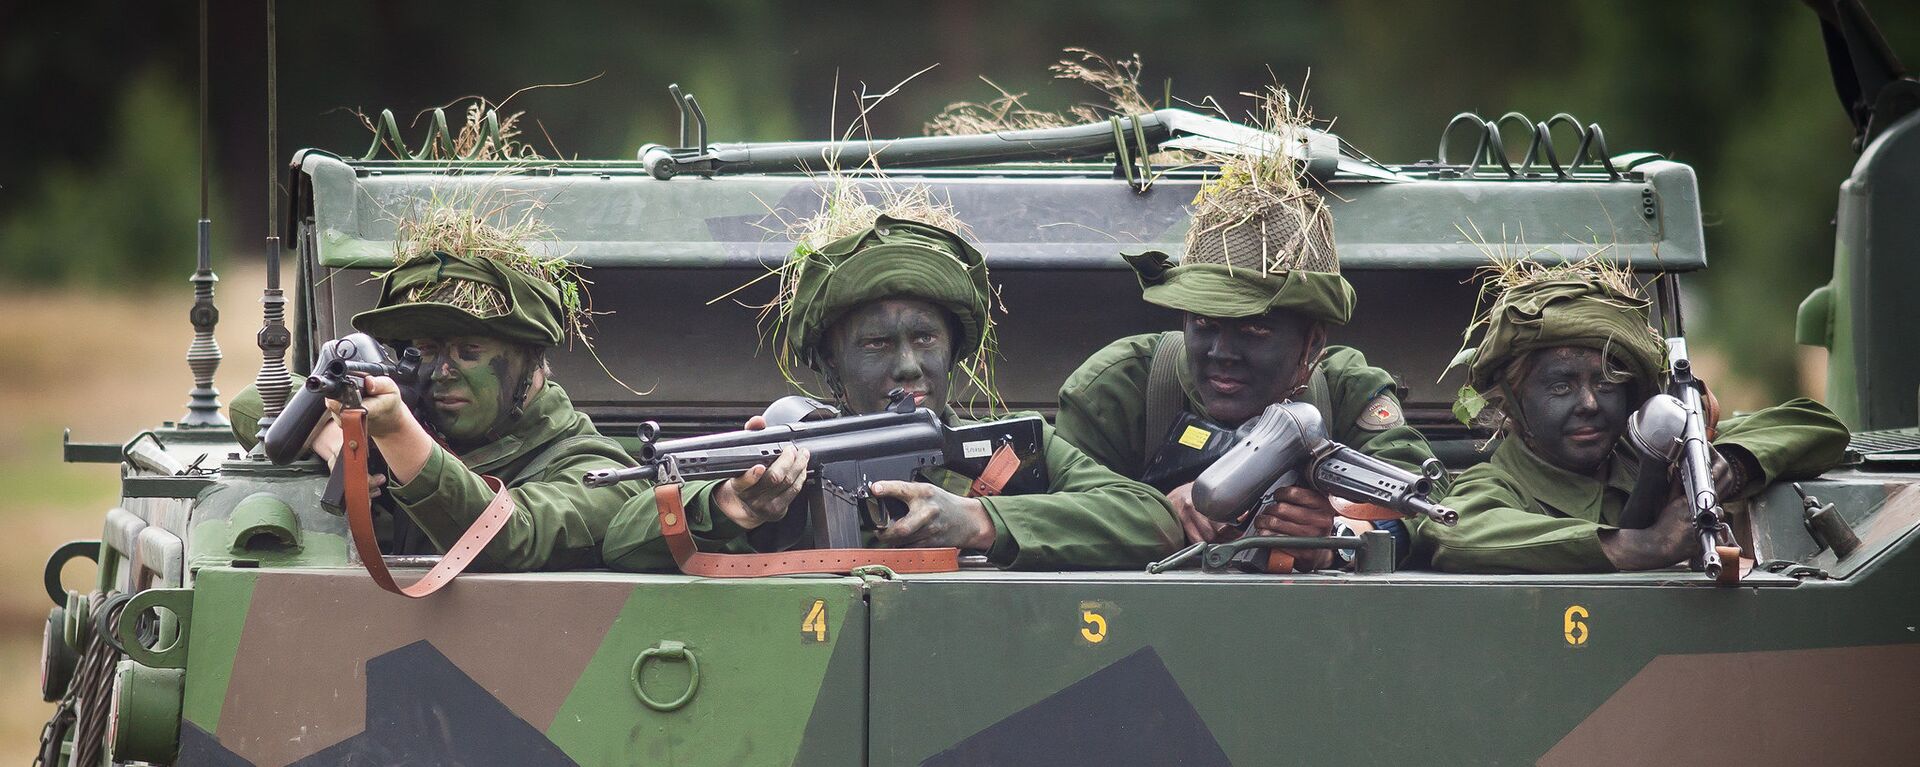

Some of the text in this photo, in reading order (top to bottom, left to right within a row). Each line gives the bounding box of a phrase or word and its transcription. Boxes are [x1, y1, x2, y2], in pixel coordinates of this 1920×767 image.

[801, 600, 826, 642] 4
[1081, 602, 1107, 643] 5
[1564, 605, 1589, 645] 6
